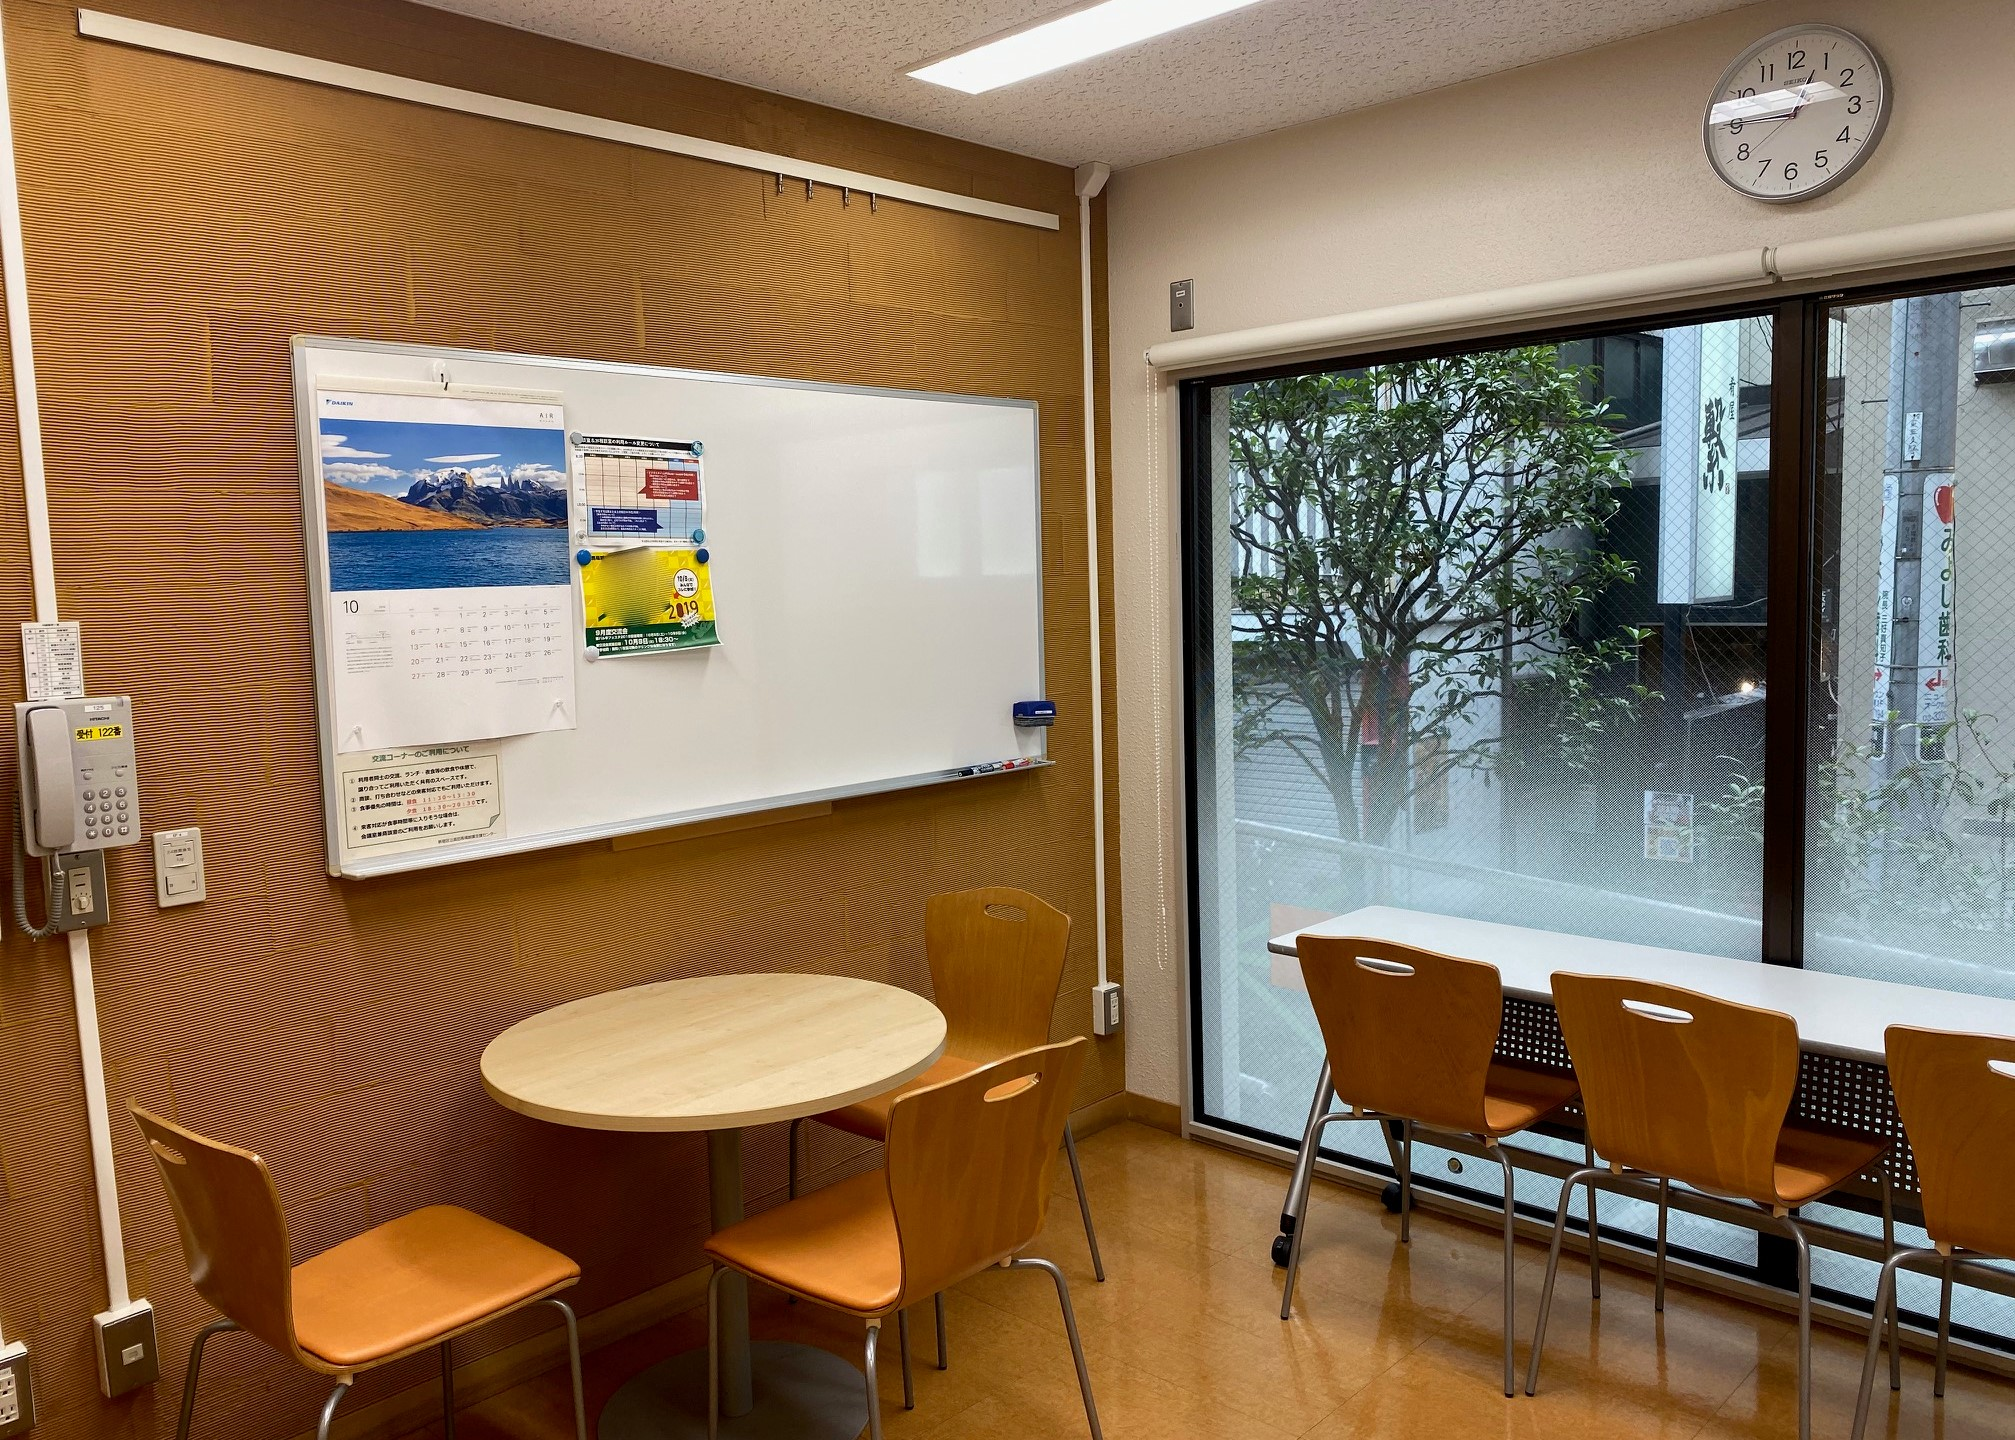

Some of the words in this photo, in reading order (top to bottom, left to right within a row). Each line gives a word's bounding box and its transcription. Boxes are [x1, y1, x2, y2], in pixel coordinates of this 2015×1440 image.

[1788, 50, 1806, 70] 12
[1824, 52, 1828, 70] 1
[1760, 64, 1774, 82] 11
[1840, 68, 1854, 87] 2
[1847, 95, 1862, 114] 3
[1730, 118, 1743, 134] 9
[1836, 126, 1850, 143] 4
[1737, 143, 1750, 161] 8
[1814, 150, 1828, 167] 5
[1758, 159, 1772, 177] 7
[1784, 162, 1798, 180] 6
[343, 600, 359, 614] 10
[669, 600, 698, 620] 2019
[76, 729, 93, 740] 受付
[98, 726, 122, 738] 122番
[372, 746, 470, 762] 交流コーナーのご利用について
